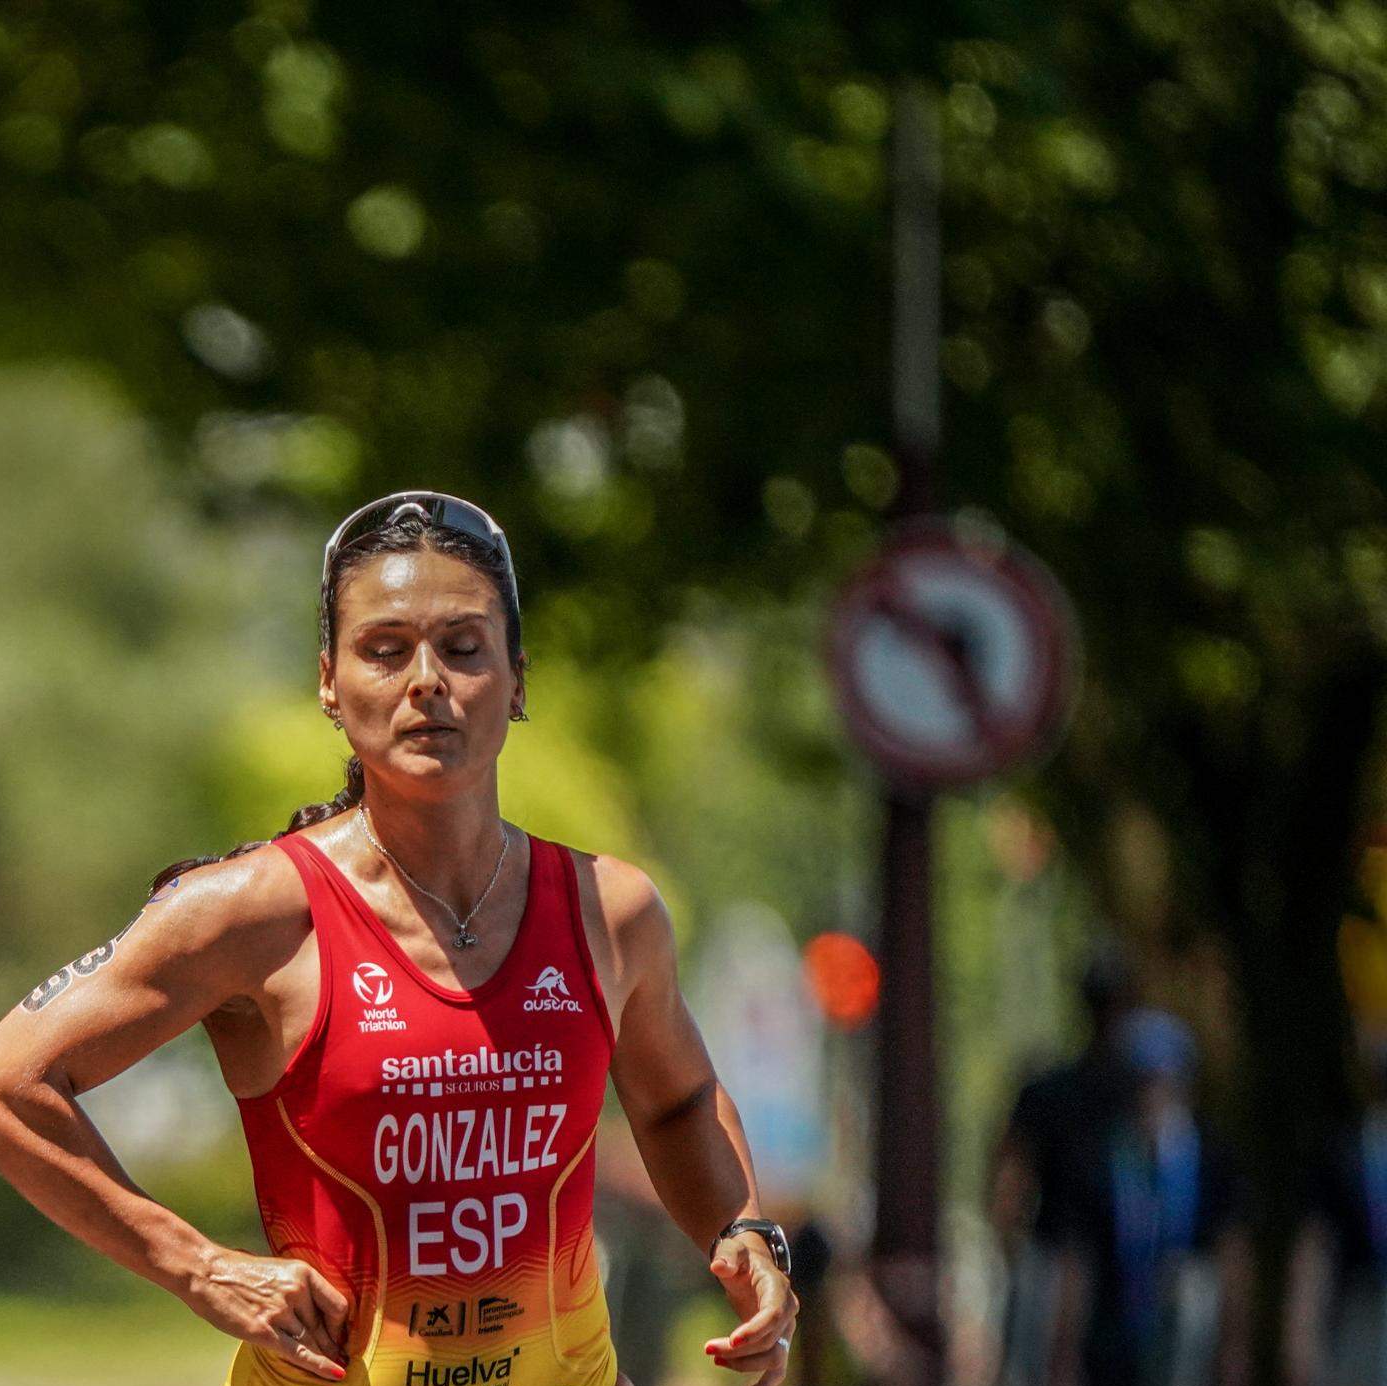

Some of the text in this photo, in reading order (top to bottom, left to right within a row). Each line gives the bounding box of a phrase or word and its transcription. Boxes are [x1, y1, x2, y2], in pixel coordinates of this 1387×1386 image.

[364, 1008, 397, 1020] World
[523, 1000, 583, 1013] austral
[358, 1018, 407, 1033] Triathlon
[382, 1043, 563, 1081] santalucía
[445, 1080, 500, 1094] SEGUROS
[374, 1103, 568, 1185] GONZALEZ
[409, 1192, 528, 1276] ESP
